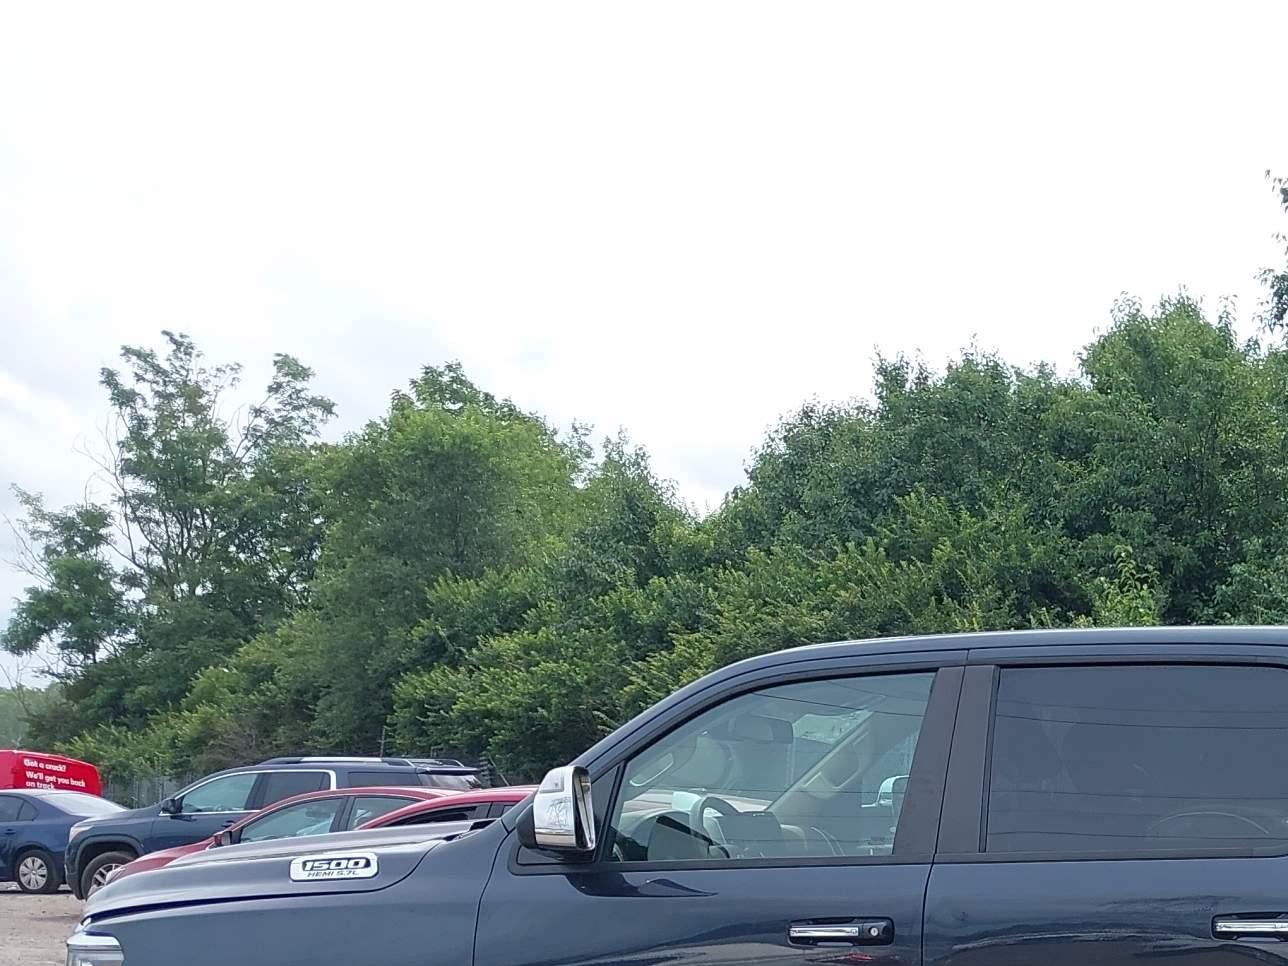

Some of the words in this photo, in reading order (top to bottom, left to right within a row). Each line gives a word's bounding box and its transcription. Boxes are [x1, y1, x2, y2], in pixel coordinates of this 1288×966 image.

[24, 759, 38, 768] Got
[45, 764, 66, 772] crack?
[26, 771, 43, 779] We'll
[44, 775, 57, 783] get
[57, 776, 70, 785] you
[70, 778, 86, 788] back
[304, 859, 365, 871] 1500
